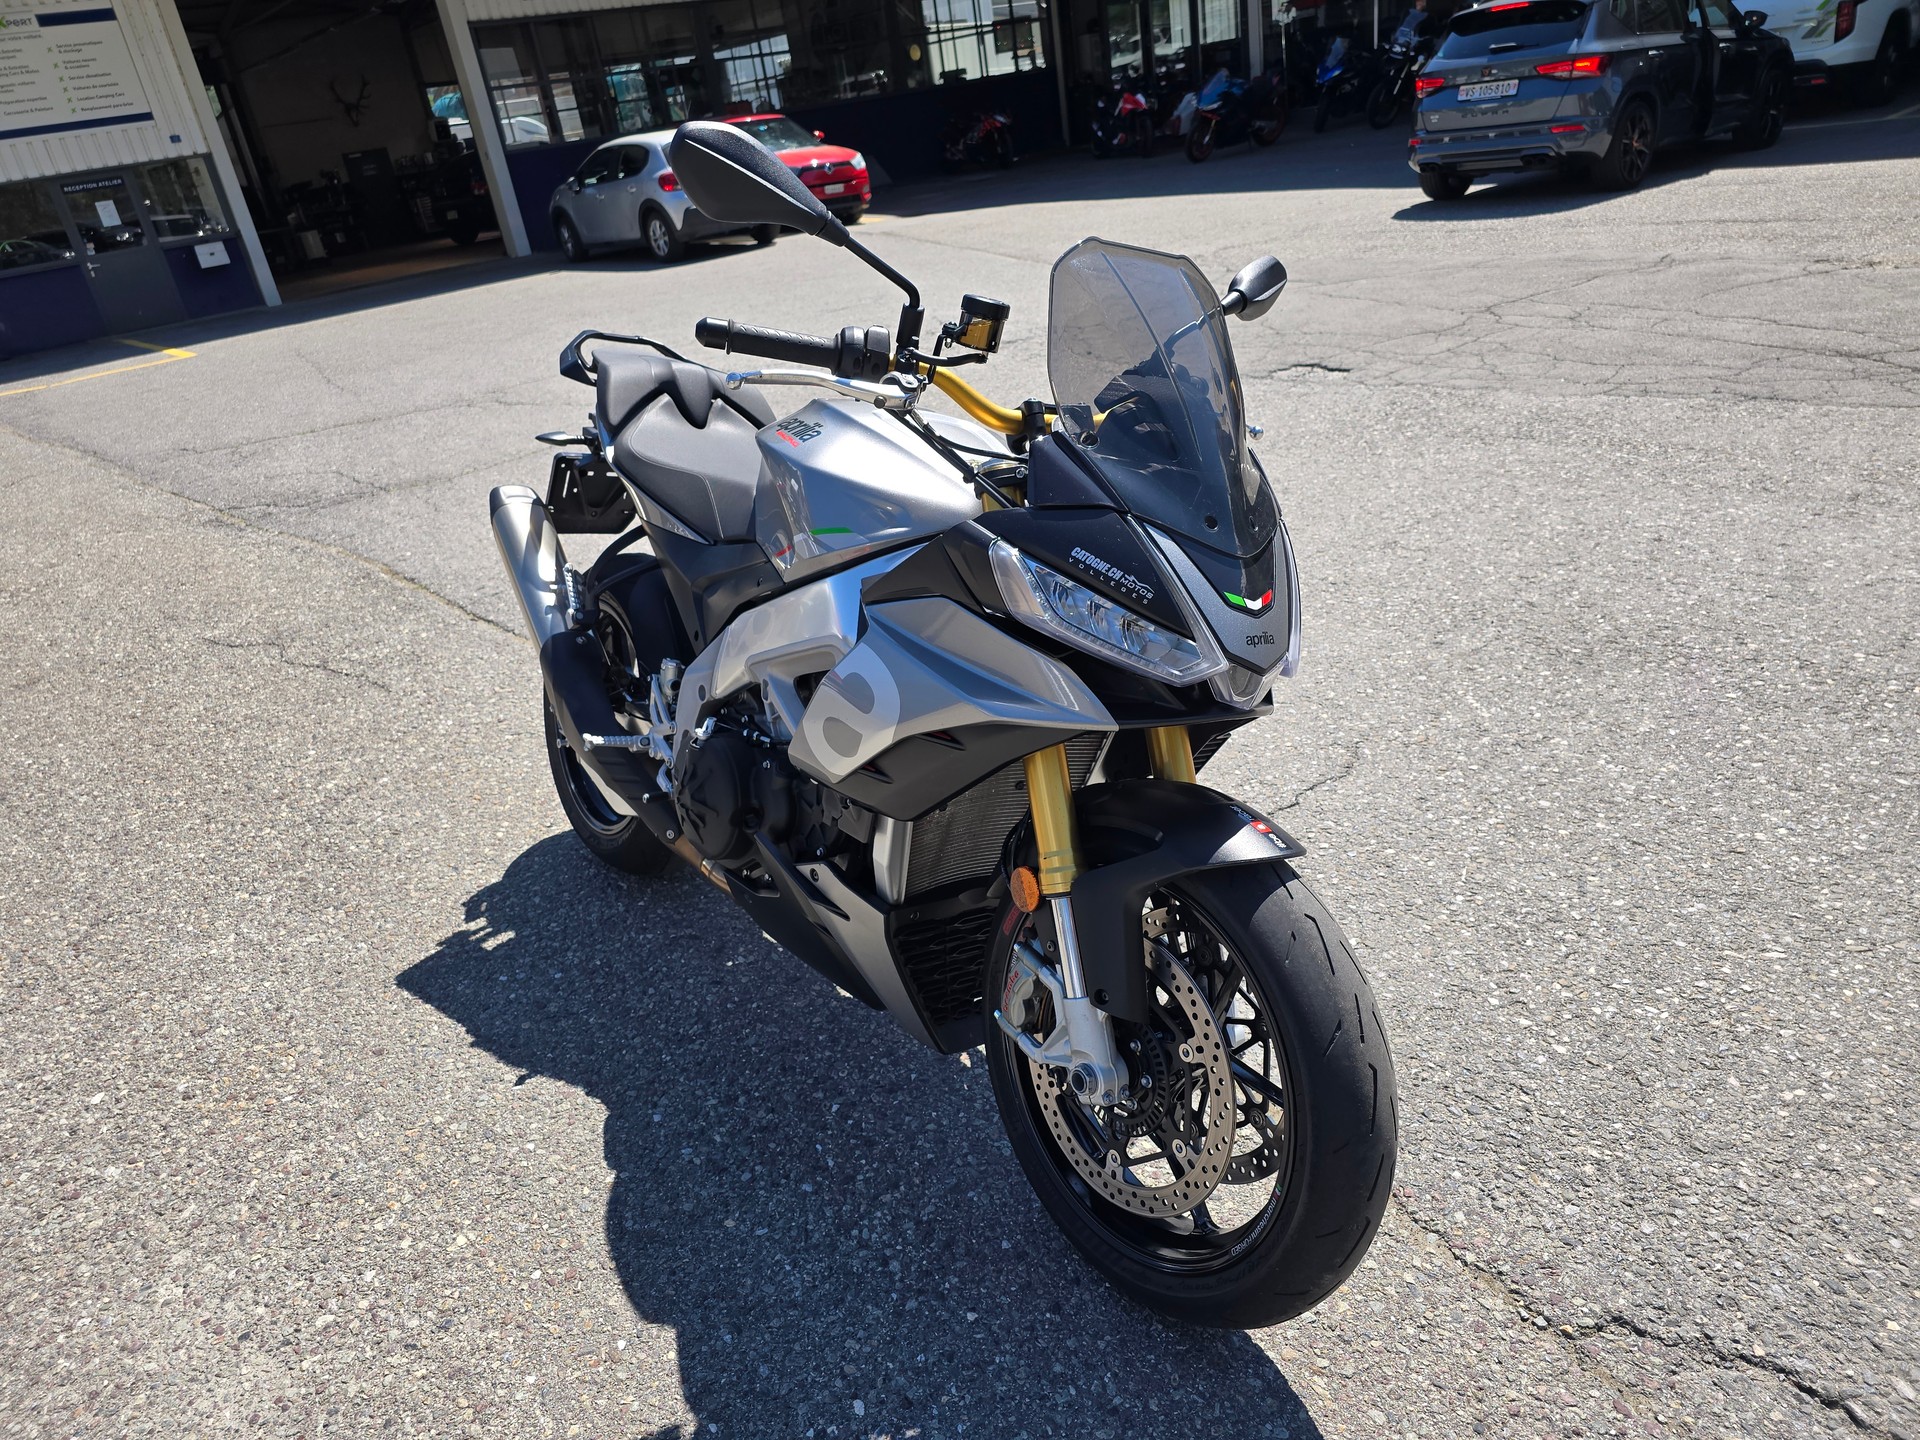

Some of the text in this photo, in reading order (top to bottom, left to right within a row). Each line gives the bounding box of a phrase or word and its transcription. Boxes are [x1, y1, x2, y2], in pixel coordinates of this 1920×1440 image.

[98, 178, 122, 187] ATELIER
[776, 418, 823, 443] aprilia
[1071, 546, 1154, 599] CATOGNE.CH MOTOS
[1246, 631, 1274, 648] aprilia
[1230, 1235, 1252, 1256] FORGED
